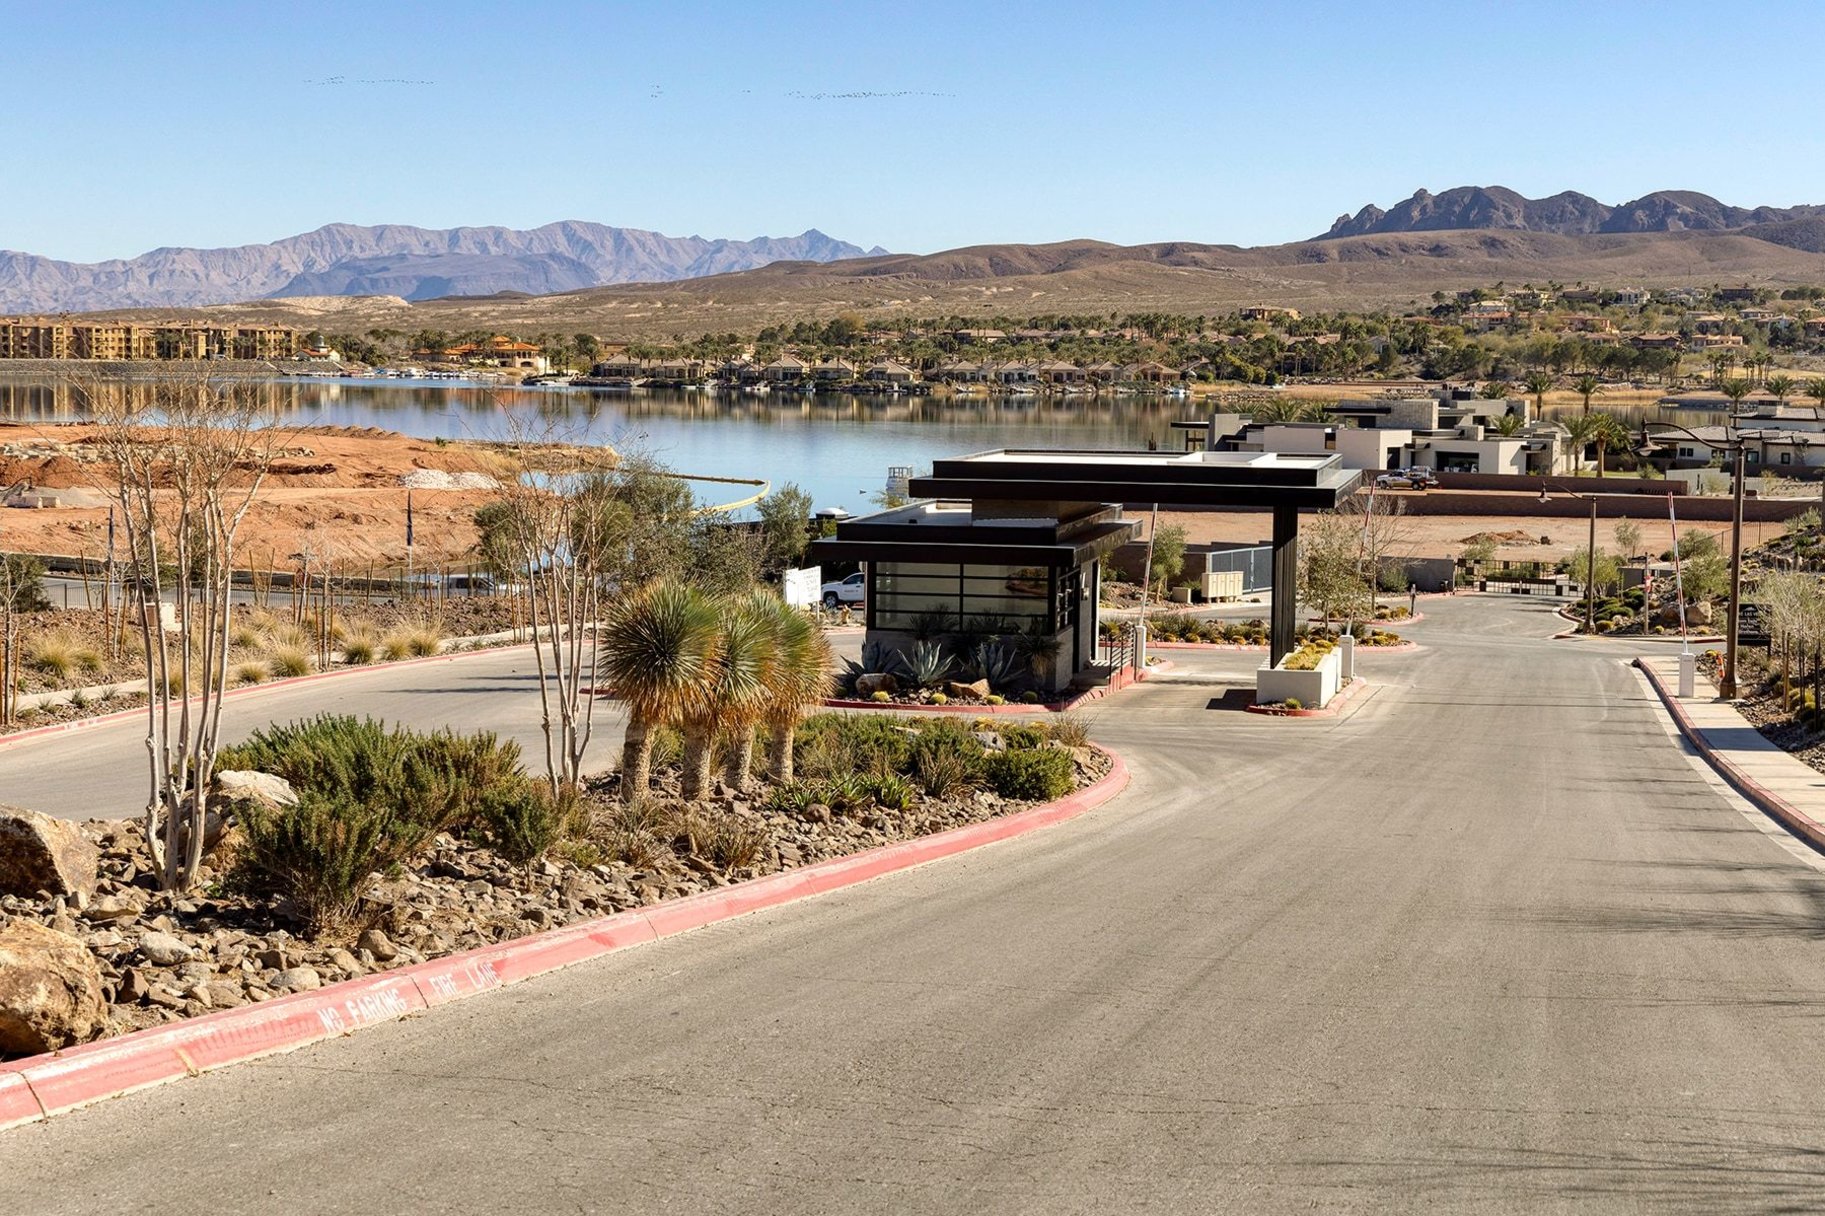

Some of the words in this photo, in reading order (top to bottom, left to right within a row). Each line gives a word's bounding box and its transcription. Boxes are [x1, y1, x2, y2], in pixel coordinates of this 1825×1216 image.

[317, 1006, 346, 1033] NO
[345, 988, 408, 1025] PARKING
[428, 973, 459, 998] FIRE
[465, 961, 503, 990] LANE
